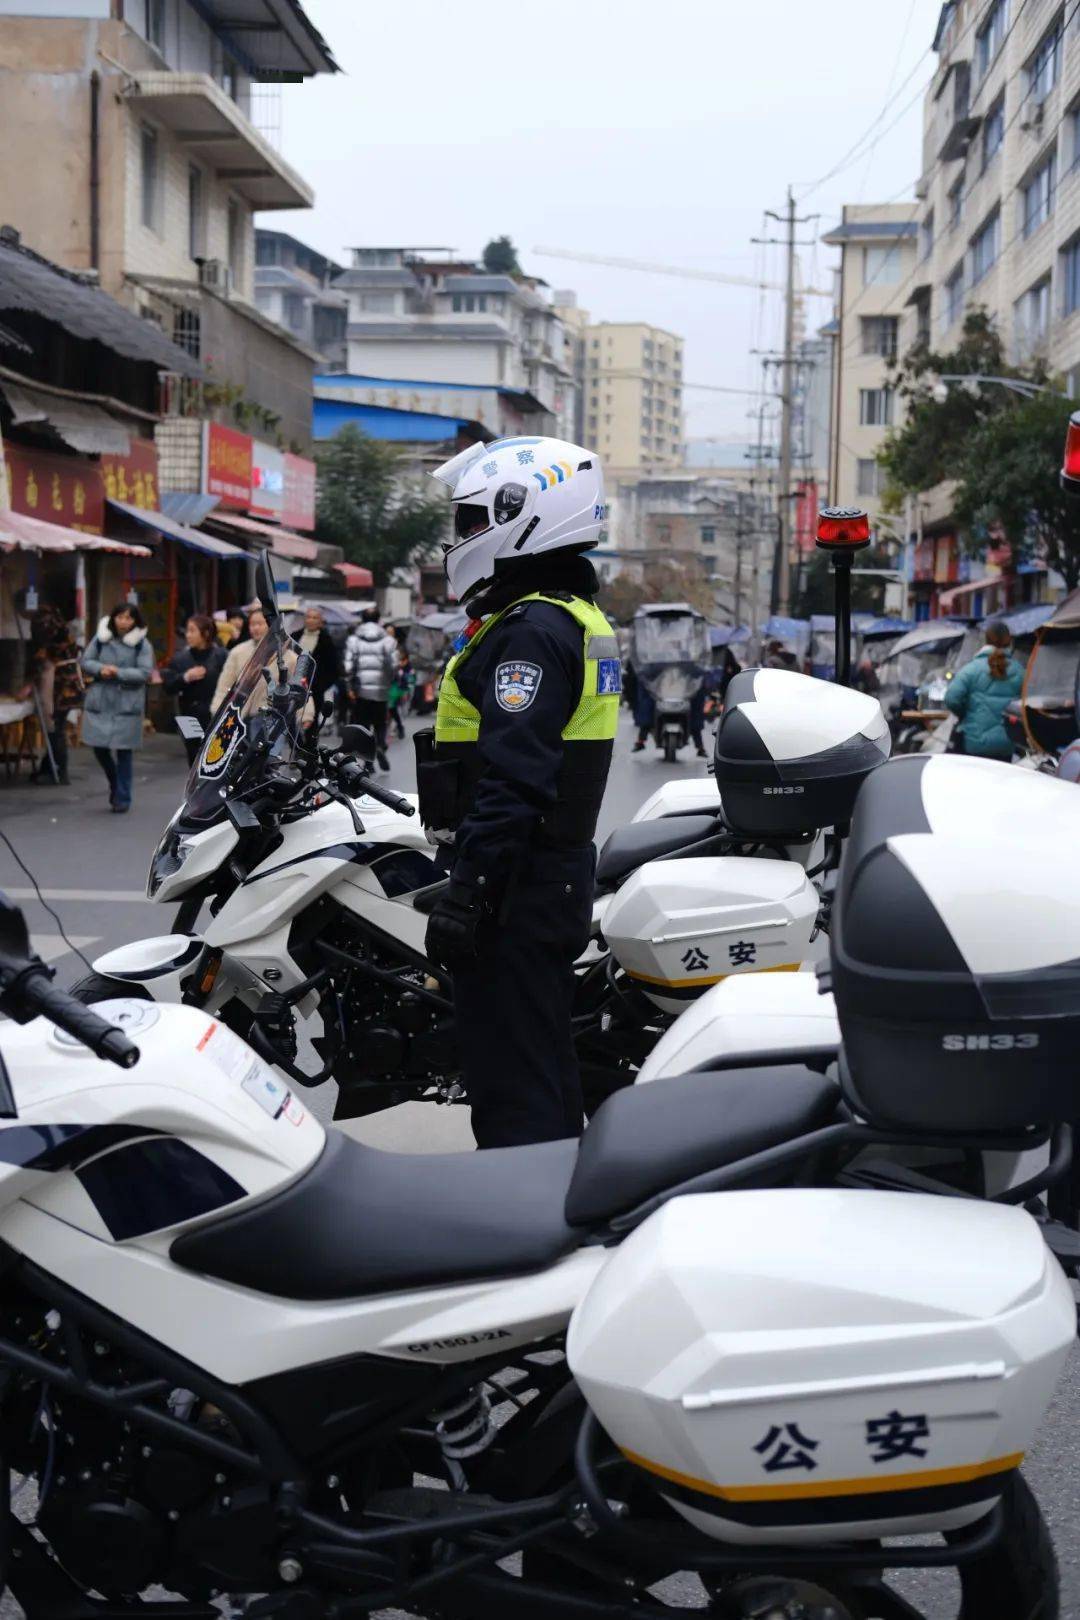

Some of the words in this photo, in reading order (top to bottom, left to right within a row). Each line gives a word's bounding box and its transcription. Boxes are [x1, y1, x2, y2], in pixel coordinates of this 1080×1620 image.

[763, 786, 805, 794] SH33
[681, 941, 756, 972] 公安
[942, 1034, 1040, 1050] SH33
[407, 1329, 512, 1353] CF150J-2A
[753, 1411, 930, 1472] 公安
